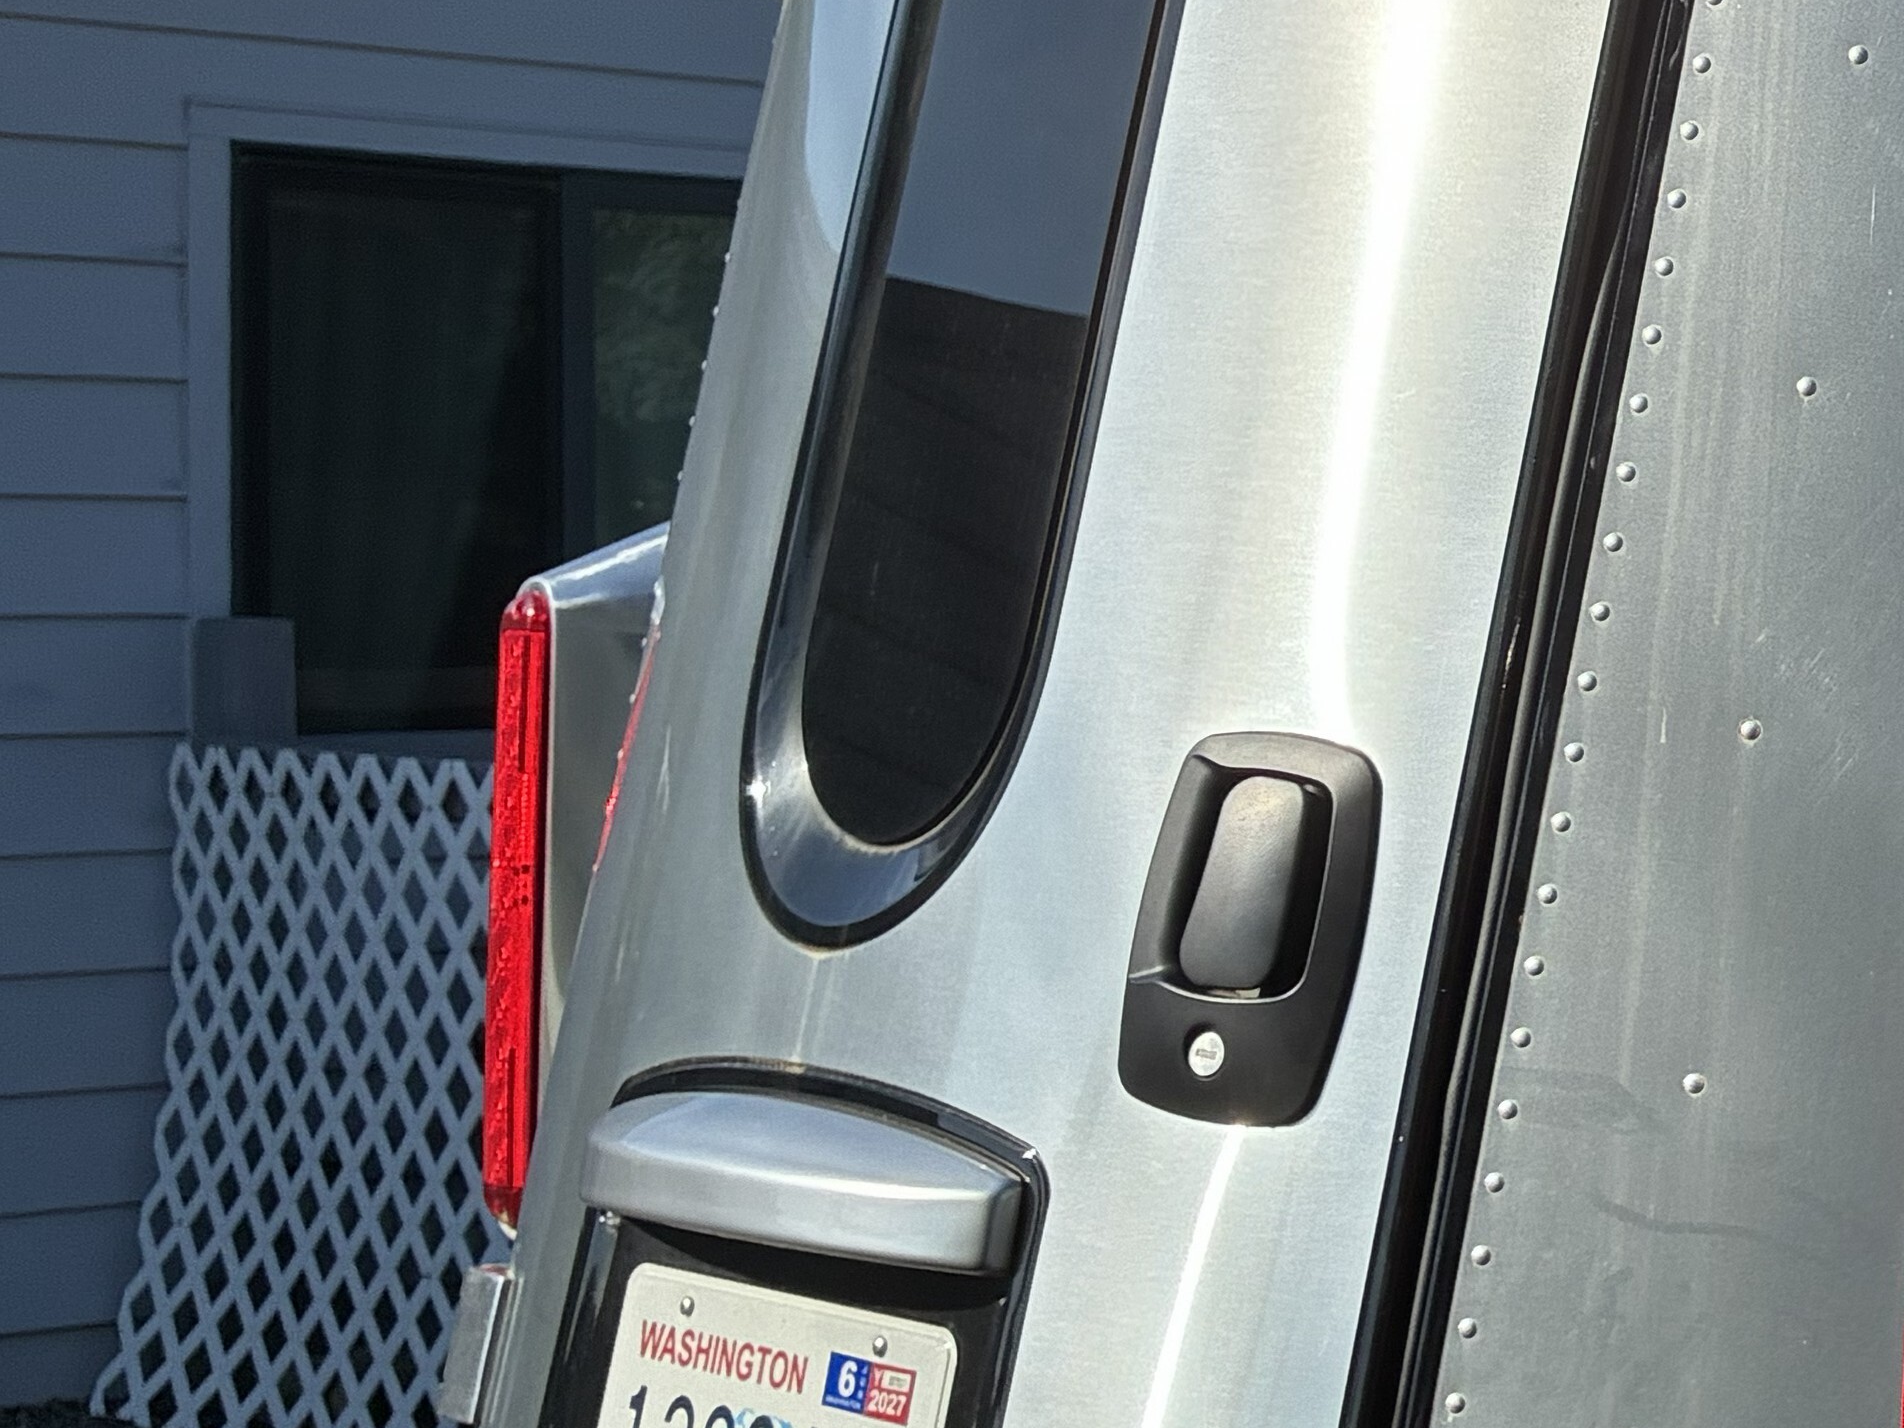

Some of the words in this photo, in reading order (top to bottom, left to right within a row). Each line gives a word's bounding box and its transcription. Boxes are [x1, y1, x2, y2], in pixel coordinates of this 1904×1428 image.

[639, 1319, 809, 1395] WASHINGTON
[837, 1359, 858, 1398] 6
[867, 1388, 907, 1417] 2027
